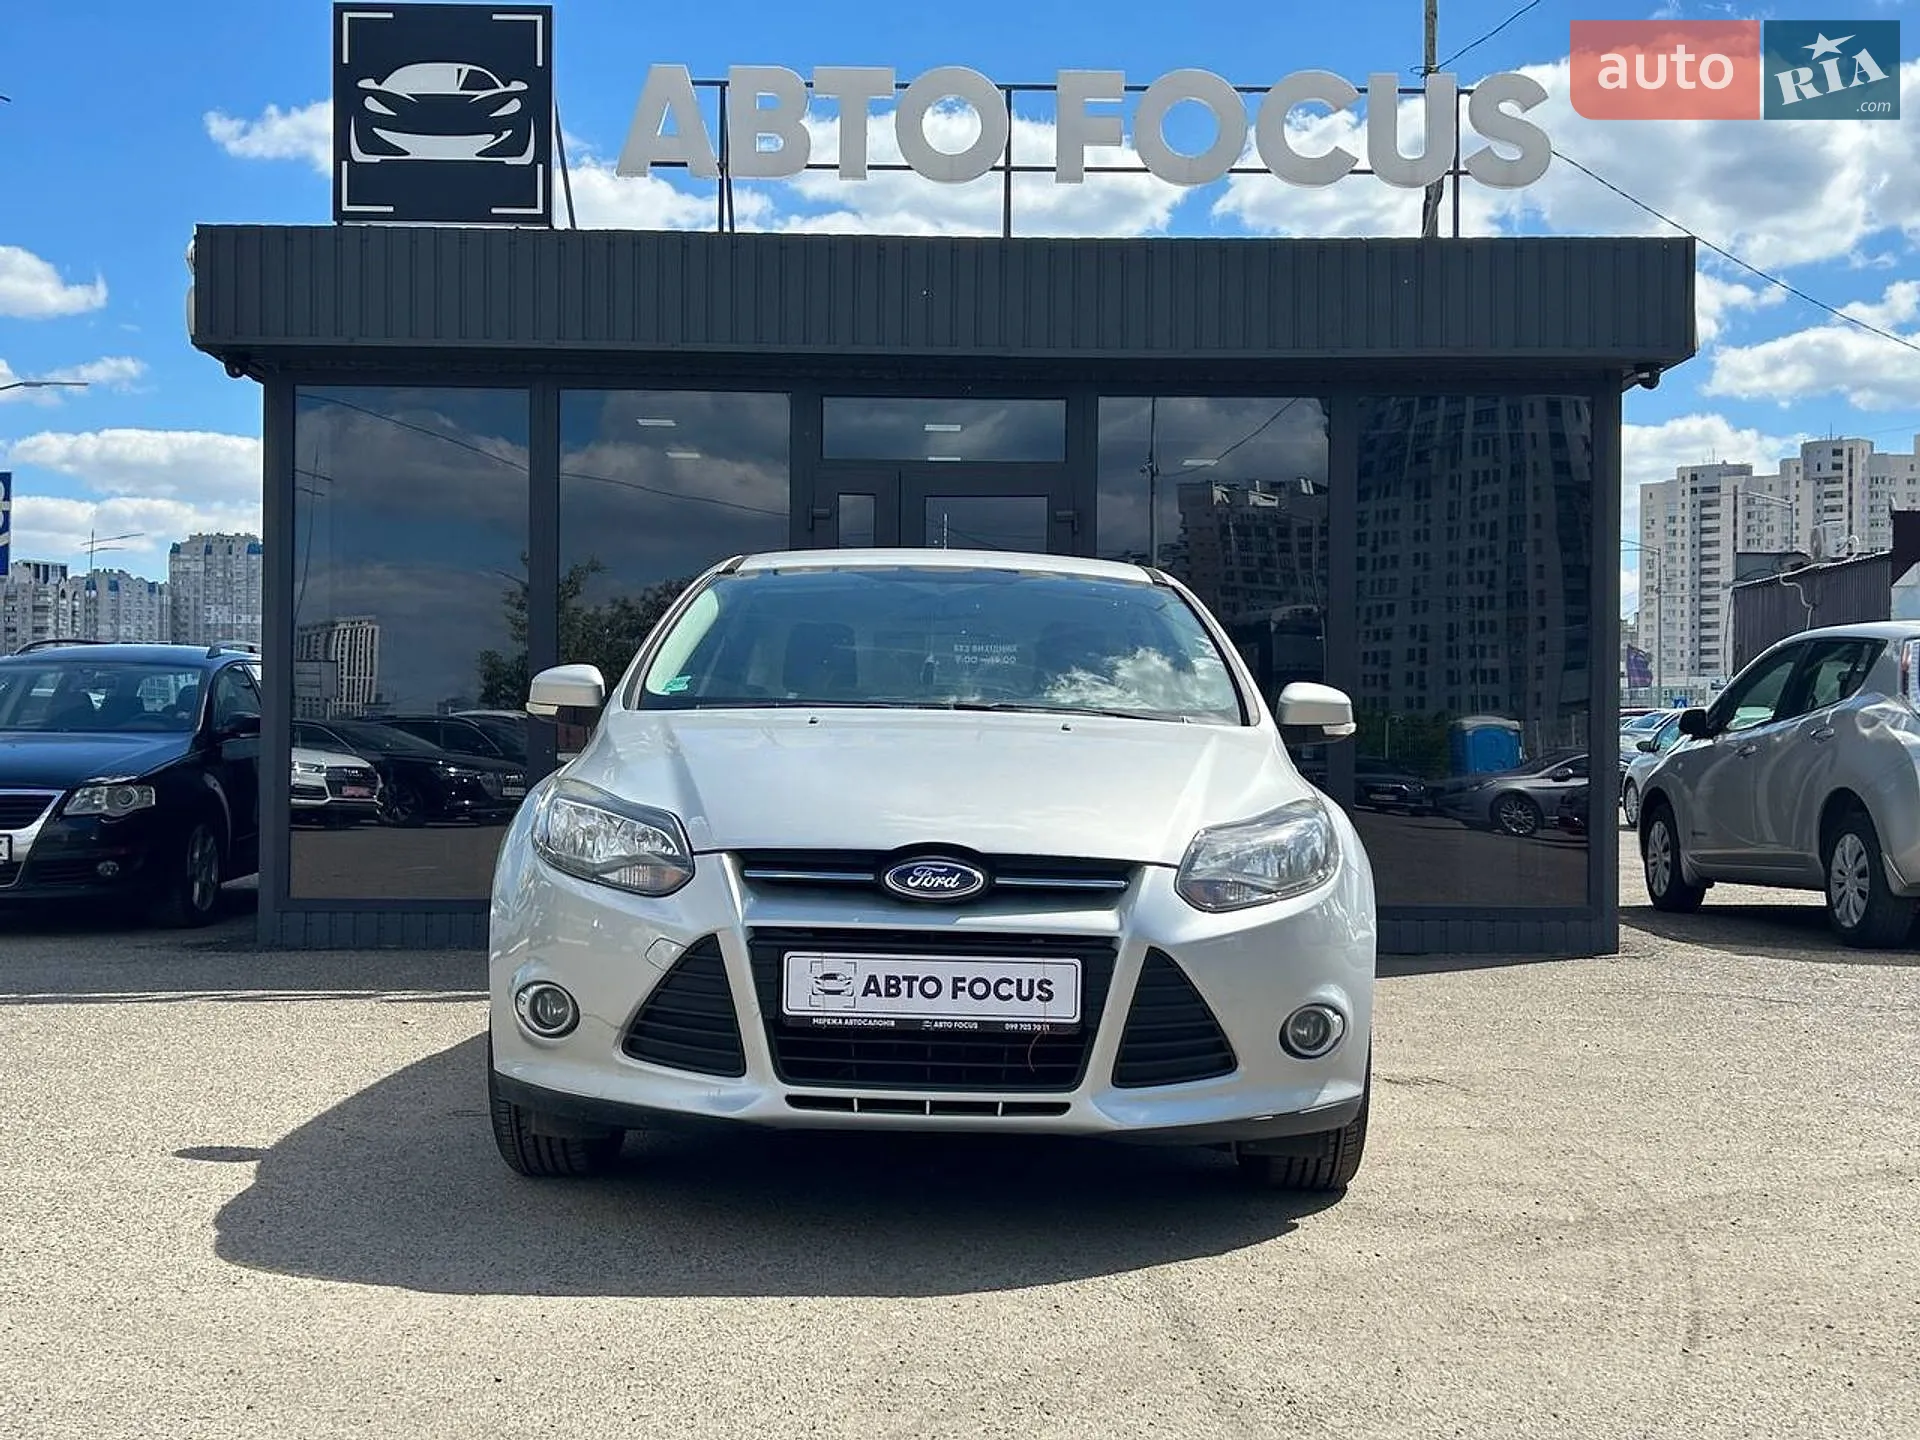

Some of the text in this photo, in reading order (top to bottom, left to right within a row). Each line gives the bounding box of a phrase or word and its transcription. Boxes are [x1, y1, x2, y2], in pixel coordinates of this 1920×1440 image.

[616, 63, 1554, 190] АВТО FOCUS
[907, 866, 961, 888] Ford
[861, 974, 1055, 1002] АВТО FOCUS
[933, 1021, 978, 1030] АВТО FOCUS
